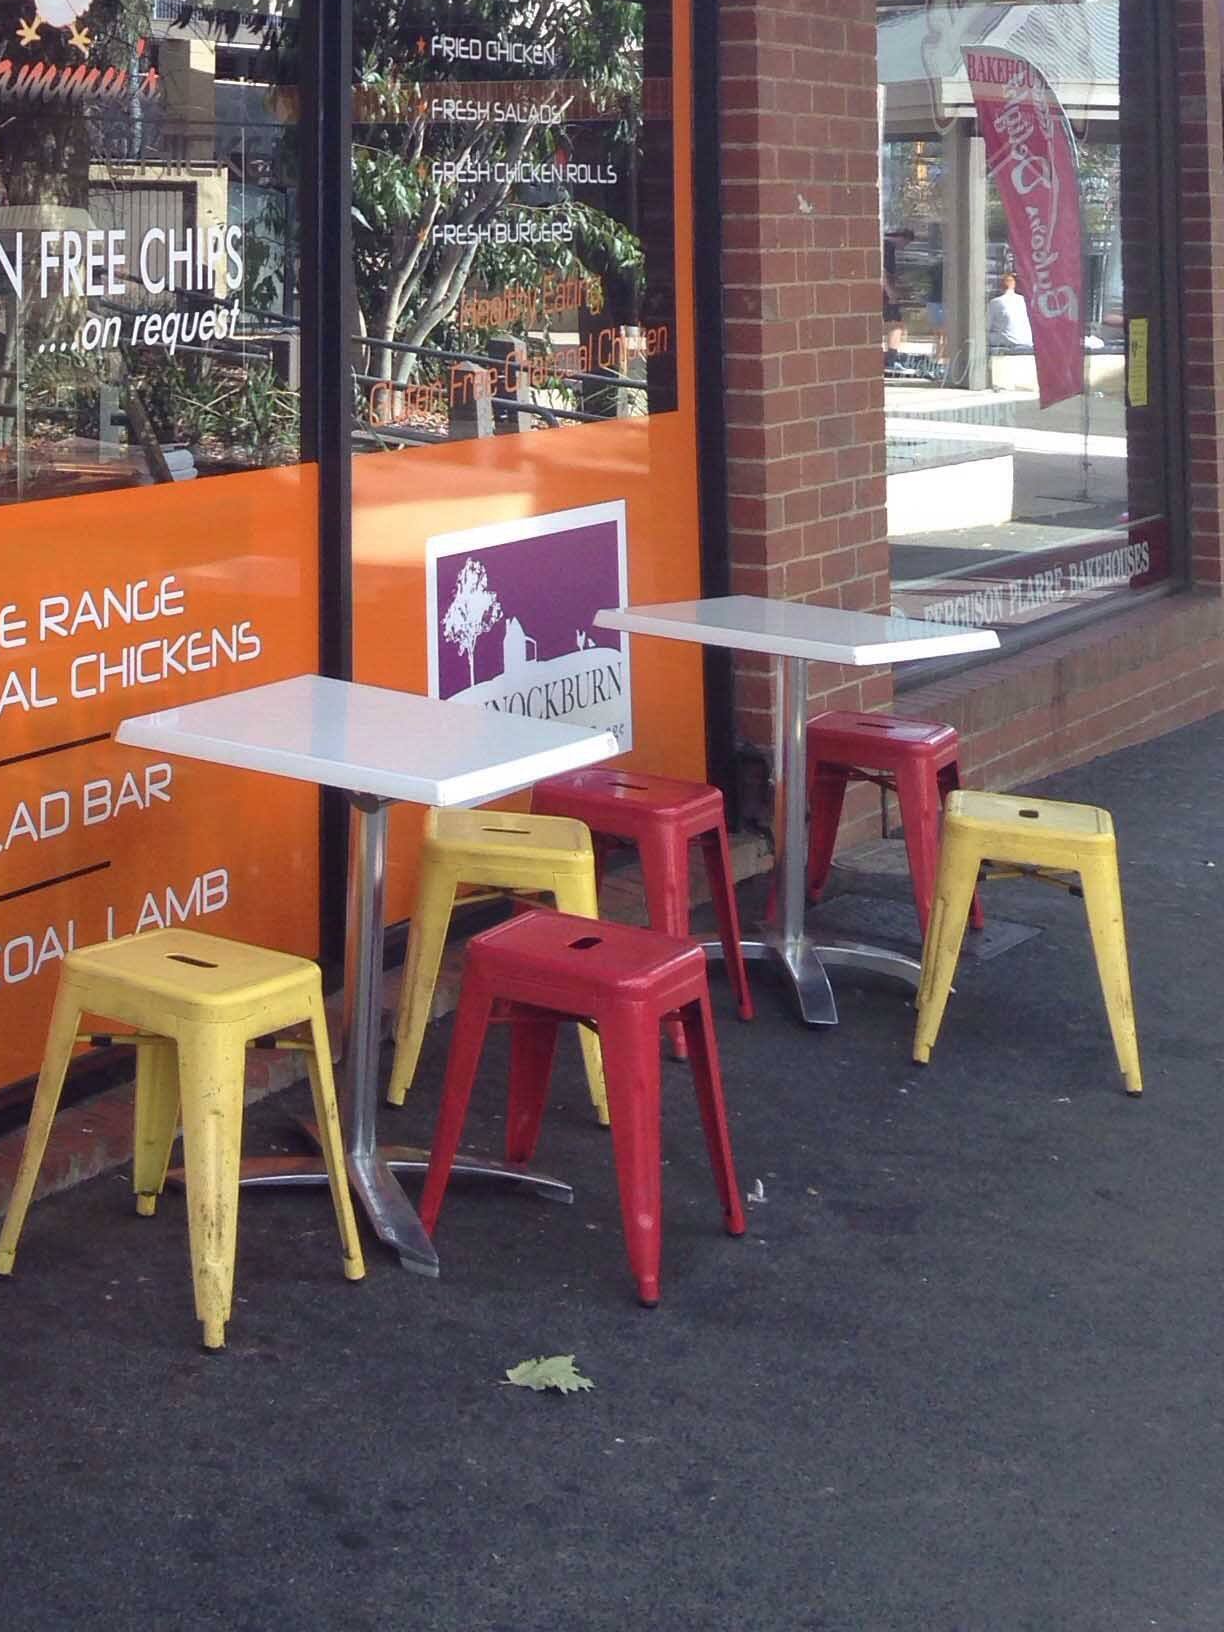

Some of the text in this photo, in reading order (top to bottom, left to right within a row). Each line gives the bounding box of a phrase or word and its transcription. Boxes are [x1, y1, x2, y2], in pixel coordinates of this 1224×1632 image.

[431, 35, 556, 66] FRIED CHICKEN
[431, 98, 562, 125] FRESH SALADS
[431, 161, 618, 184] FRESH CHICKEN ROLLS
[40, 229, 127, 300] FREE
[139, 224, 244, 295] CHIPS
[431, 222, 573, 246] FRESH BURGERS
[130, 298, 240, 356] request
[450, 362, 498, 406] Free
[39, 574, 186, 642] RANGE
[923, 584, 1005, 627] FERGUSON
[1068, 541, 1150, 595] BAKEHOUSES
[69, 620, 262, 700] CHICKENS
[82, 761, 174, 828] BAR
